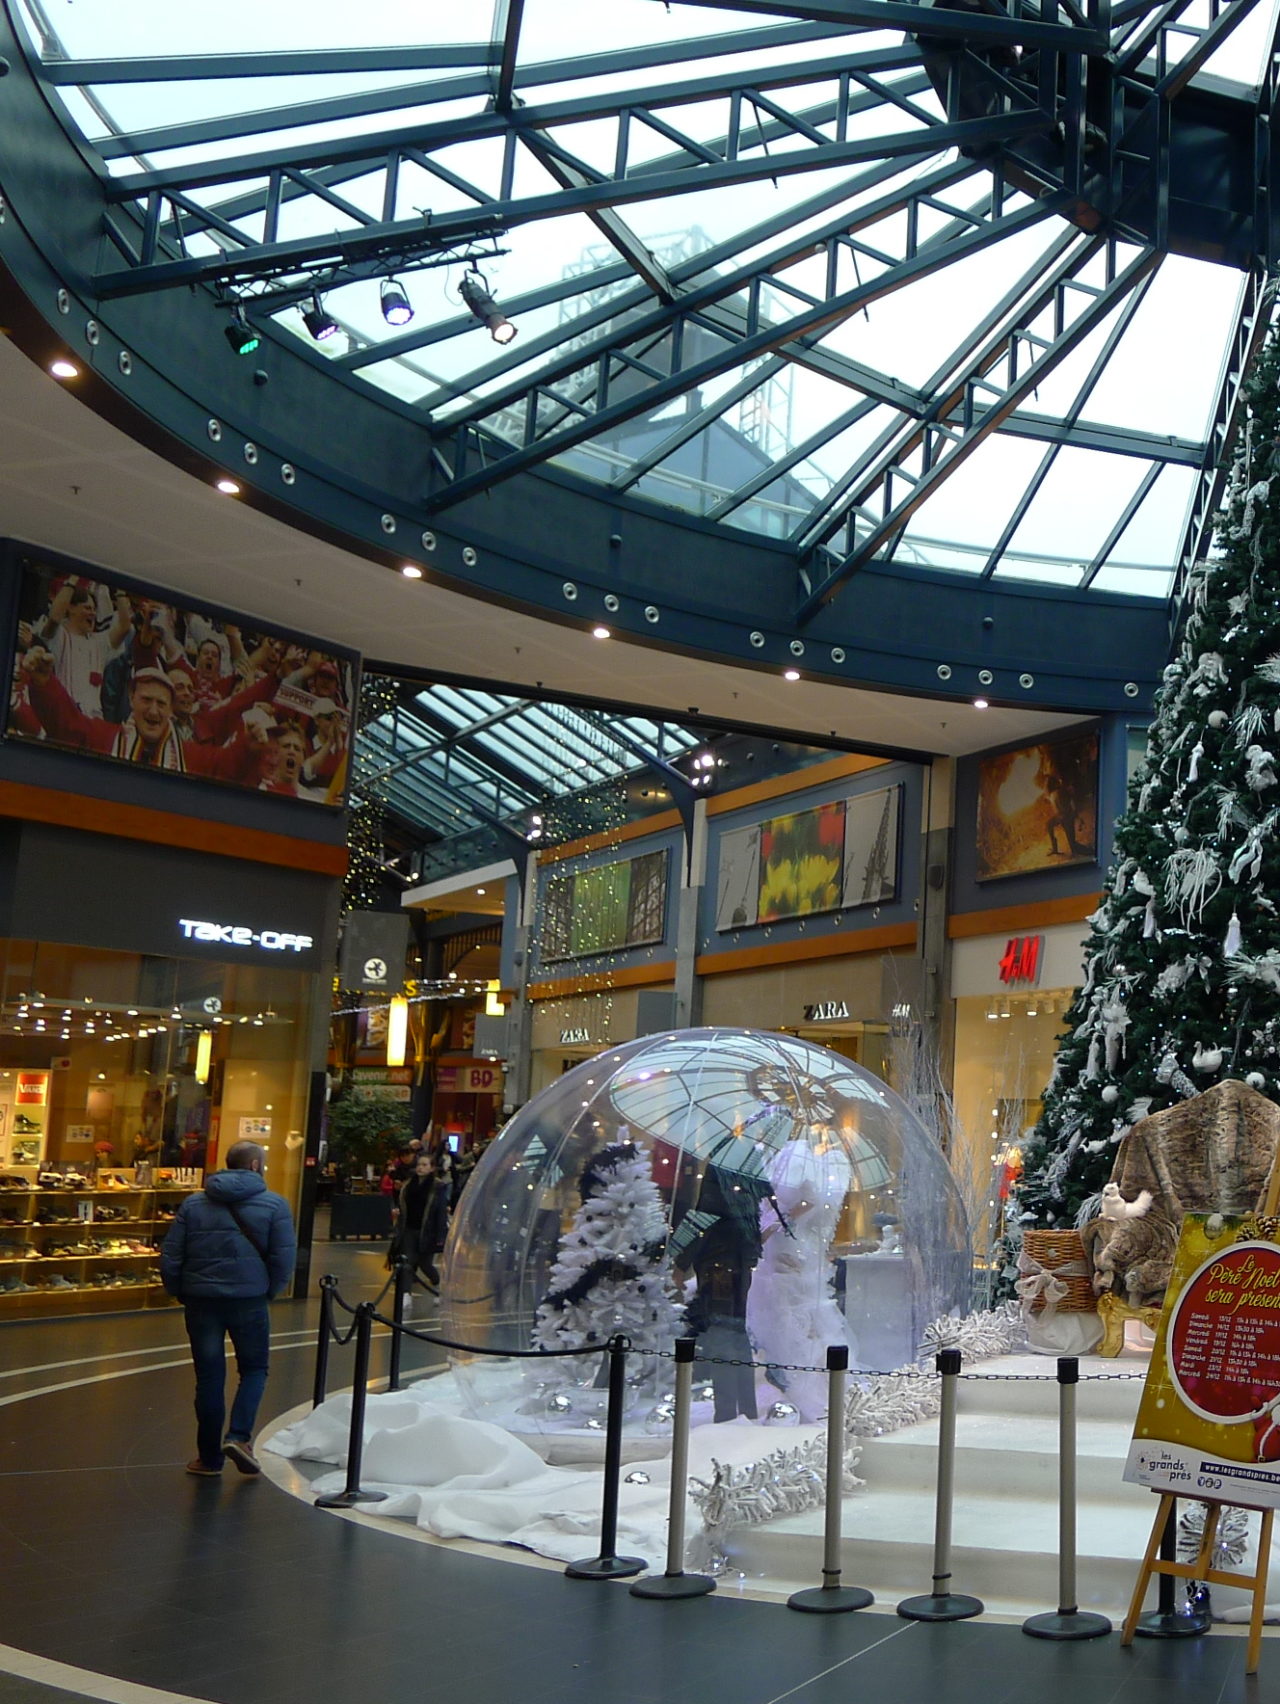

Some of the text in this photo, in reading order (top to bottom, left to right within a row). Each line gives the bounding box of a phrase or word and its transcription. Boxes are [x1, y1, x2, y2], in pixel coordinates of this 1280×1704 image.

[998, 935, 1044, 985] H&M
[803, 1000, 850, 1021] ZARA
[1236, 1254, 1255, 1273] Le
[1206, 1263, 1243, 1285] Père
[1204, 1288, 1235, 1305] sera
[1161, 1451, 1172, 1460] les
[1148, 1459, 1185, 1472] grands
[1205, 1464, 1280, 1482] www.lesgrandspres.be
